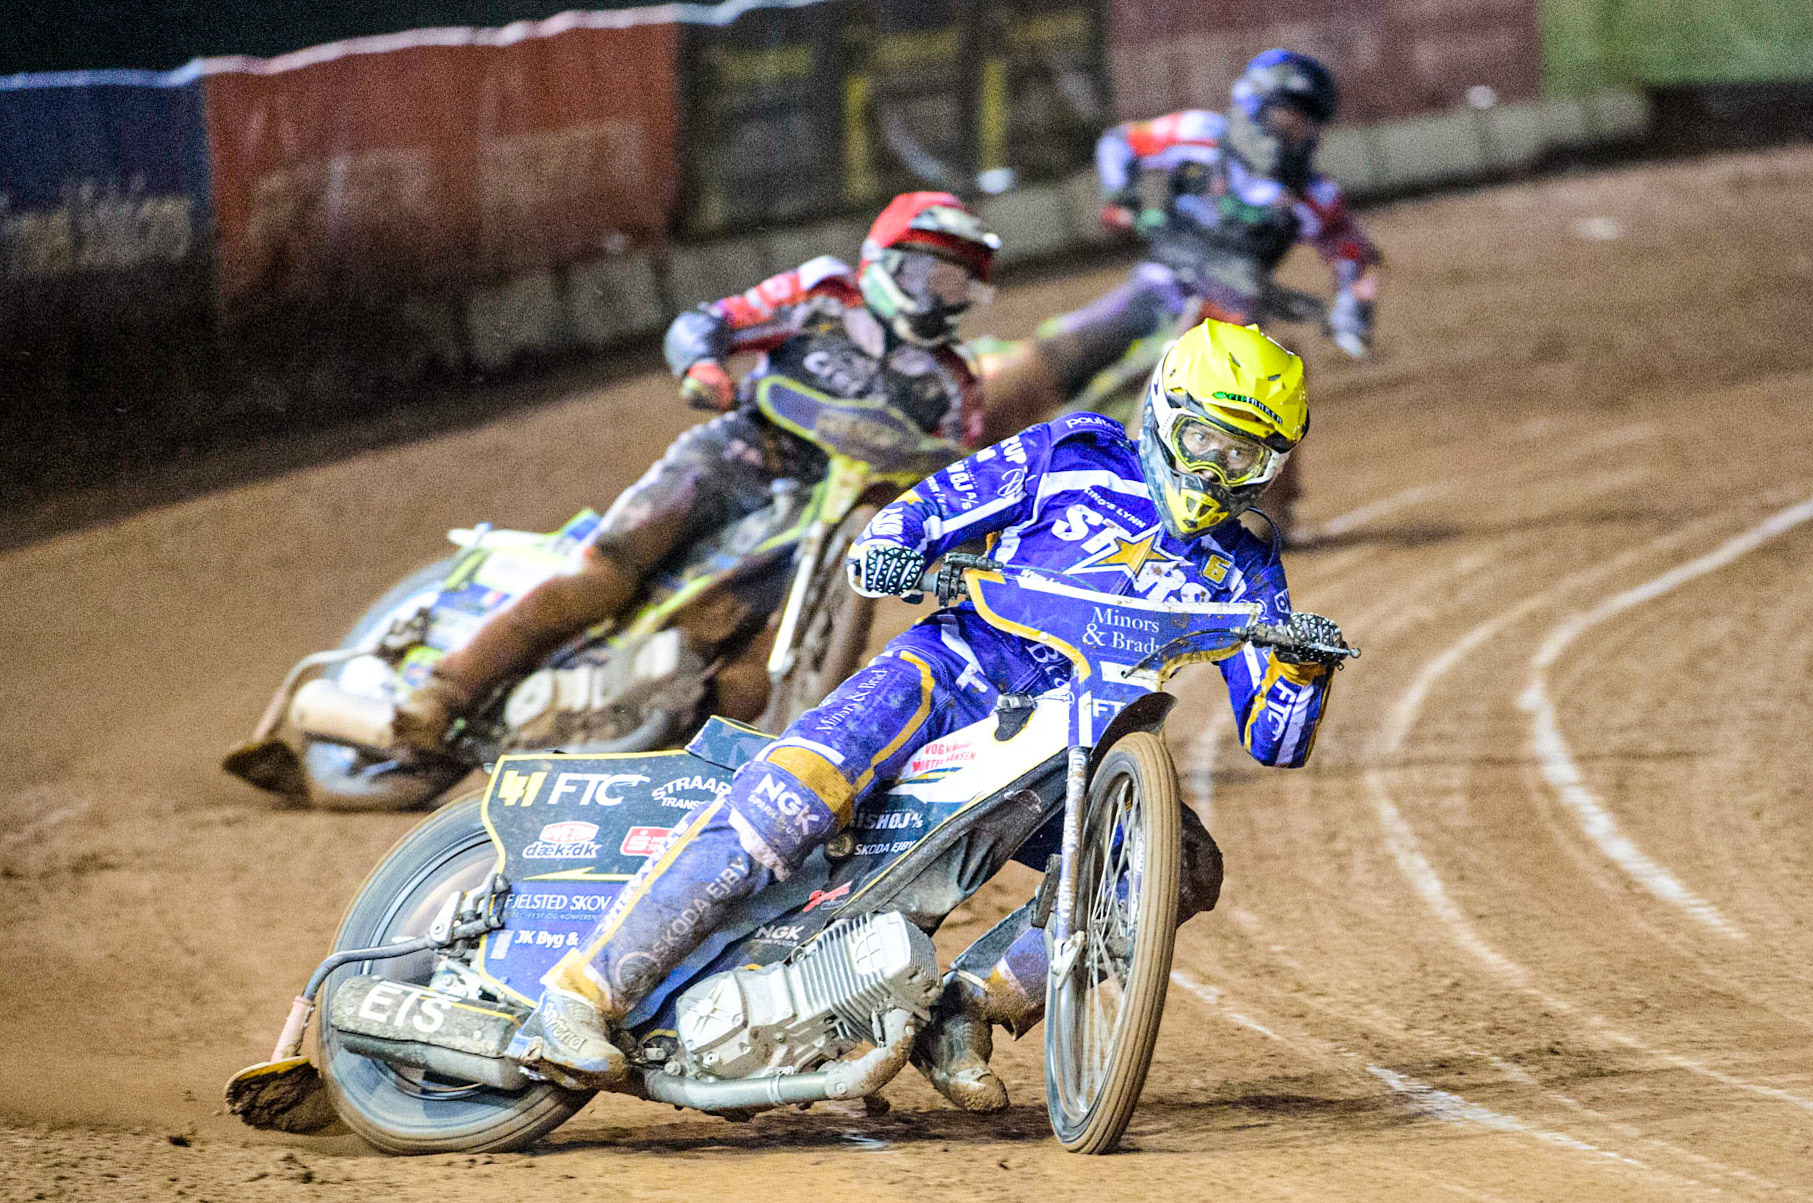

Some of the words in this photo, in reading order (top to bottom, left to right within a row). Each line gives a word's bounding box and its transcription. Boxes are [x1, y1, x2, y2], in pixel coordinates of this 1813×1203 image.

[1116, 507, 1146, 529] LYNN
[1091, 606, 1160, 634] Minors
[1082, 623, 1106, 646] &
[1112, 630, 1160, 660] Brad
[547, 772, 651, 806] FTC
[753, 773, 820, 836] NGK
[504, 893, 568, 910] FJELSTED
[569, 895, 612, 911] SKOV
[514, 930, 537, 944] JK
[536, 930, 565, 948] Byg
[565, 931, 579, 946] &
[755, 924, 805, 940] NGK
[358, 980, 461, 1033] ETS
